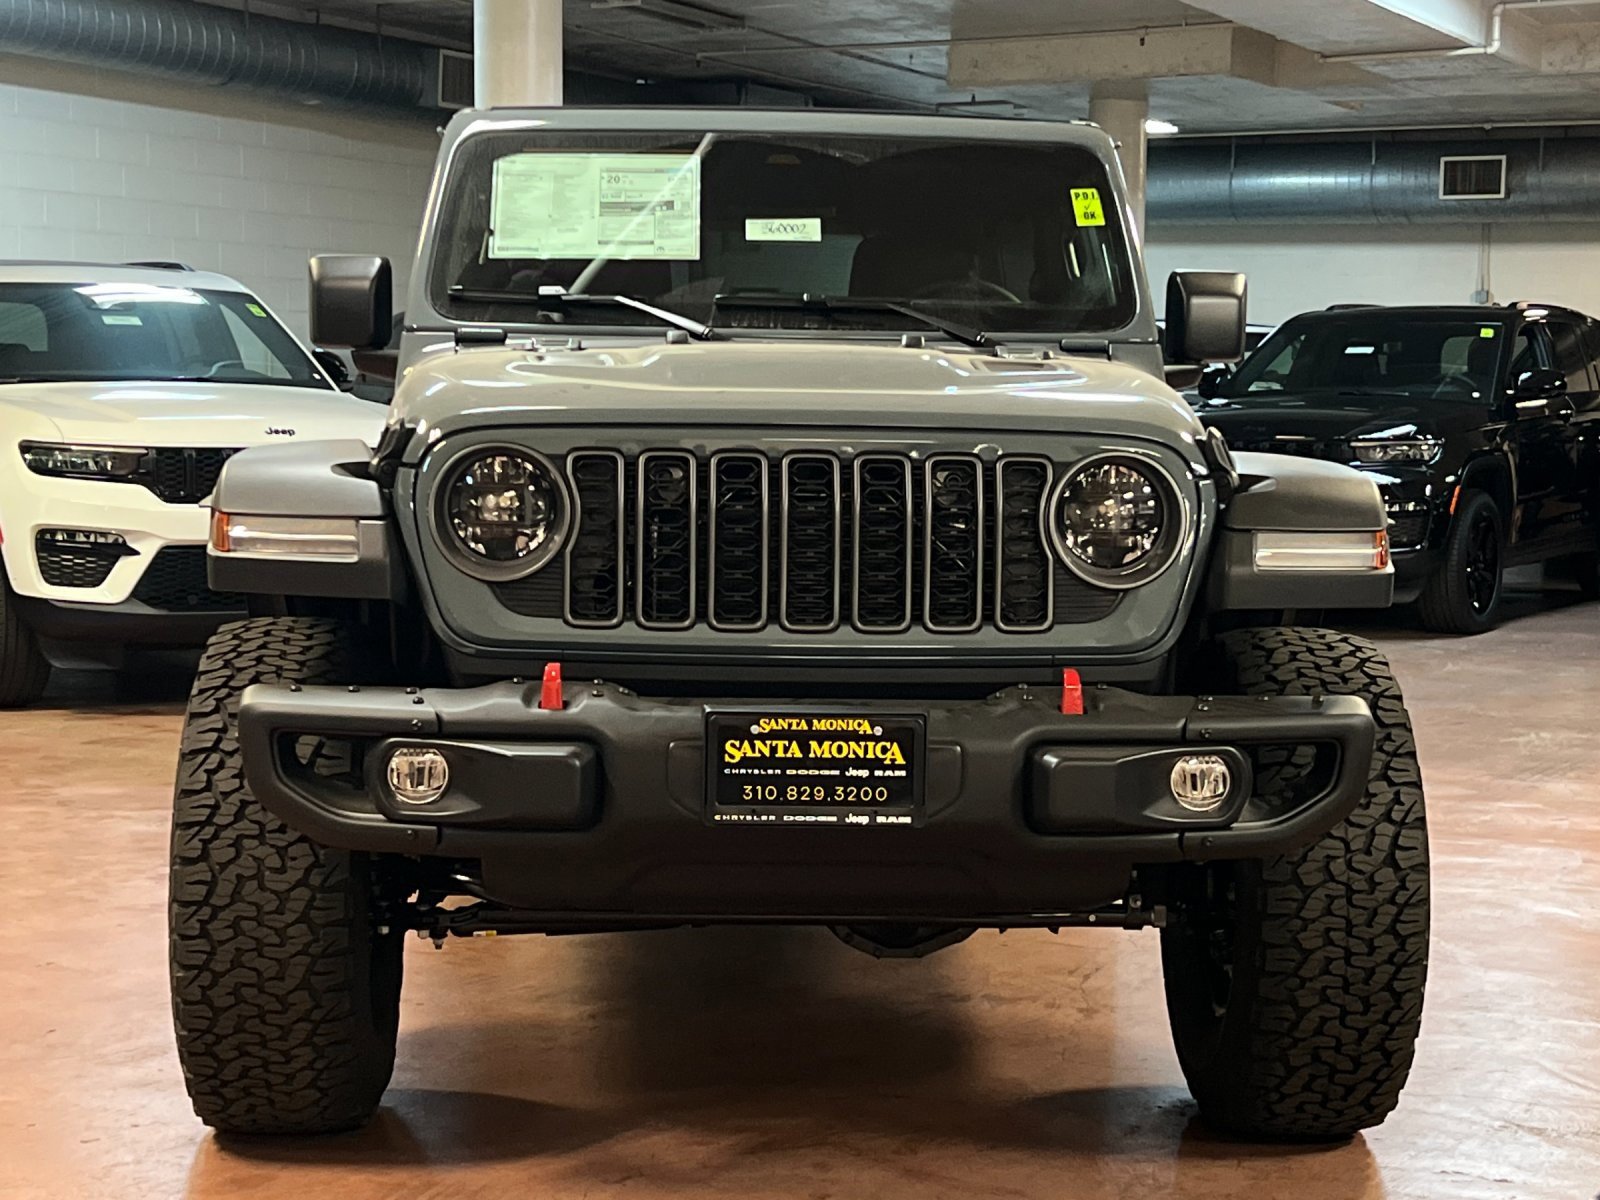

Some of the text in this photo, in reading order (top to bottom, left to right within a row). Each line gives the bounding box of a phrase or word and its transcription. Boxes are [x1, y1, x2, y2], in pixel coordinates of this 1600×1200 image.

[1083, 211, 1096, 220] OK
[264, 426, 295, 437] Jeep
[759, 719, 872, 734] SANTA MONICA
[725, 740, 906, 764] SANTA MONICA
[845, 767, 869, 778] Jeep
[874, 769, 906, 777] RAM
[743, 786, 887, 801] 310.829.3200
[845, 813, 869, 825] Jeep
[876, 815, 911, 824] RAM
